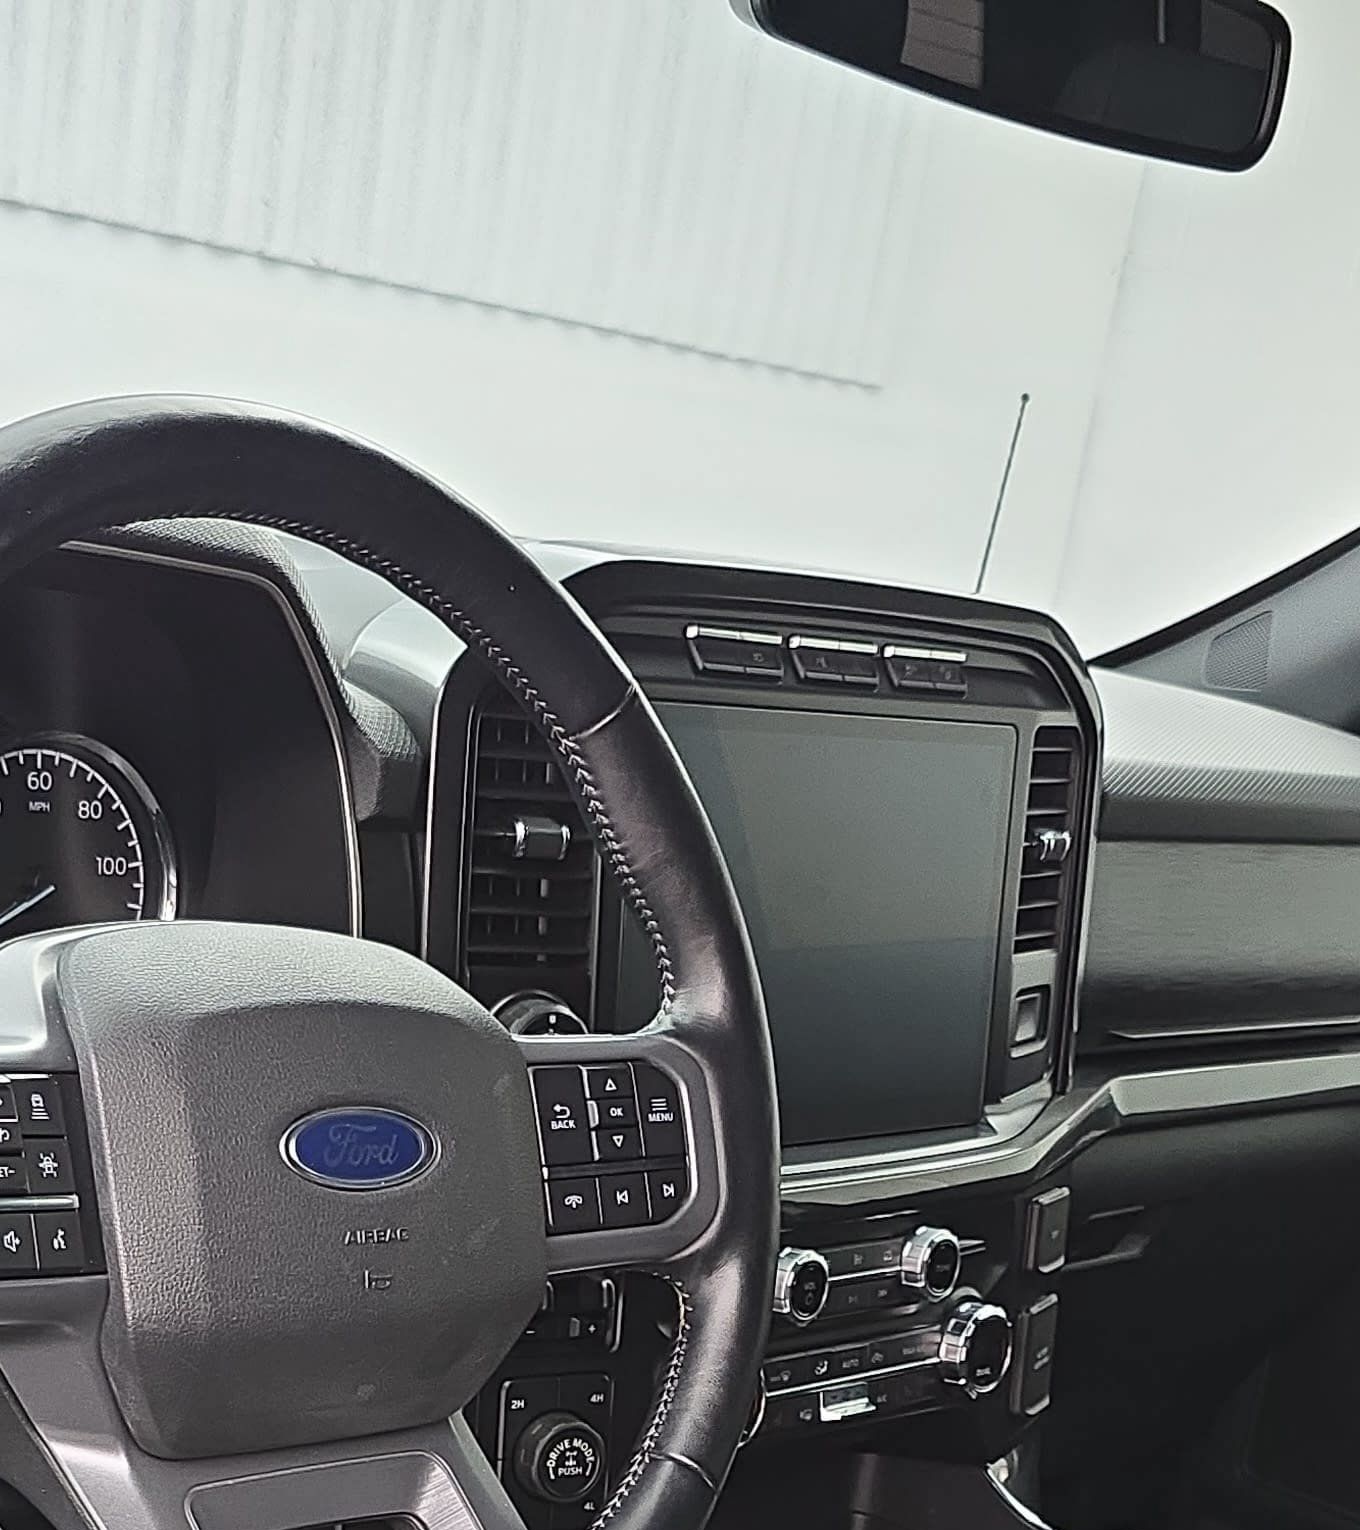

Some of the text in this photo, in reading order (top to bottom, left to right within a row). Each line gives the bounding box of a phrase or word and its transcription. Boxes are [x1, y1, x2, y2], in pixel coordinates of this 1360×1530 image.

[27, 771, 52, 790] 60
[29, 801, 51, 812] MPH
[78, 800, 102, 819] 80
[96, 856, 127, 876] 100
[609, 1107, 624, 1117] OK
[647, 1112, 674, 1122] MENU
[551, 1119, 577, 1130] BACK
[323, 1123, 400, 1168] Ford
[343, 1227, 410, 1246] AIRBAG
[590, 1393, 604, 1403] 4H
[510, 1399, 525, 1409] 2H
[546, 1437, 595, 1467] DRIVE MODE
[558, 1467, 583, 1477] PUSH
[583, 1501, 596, 1511] 4L
